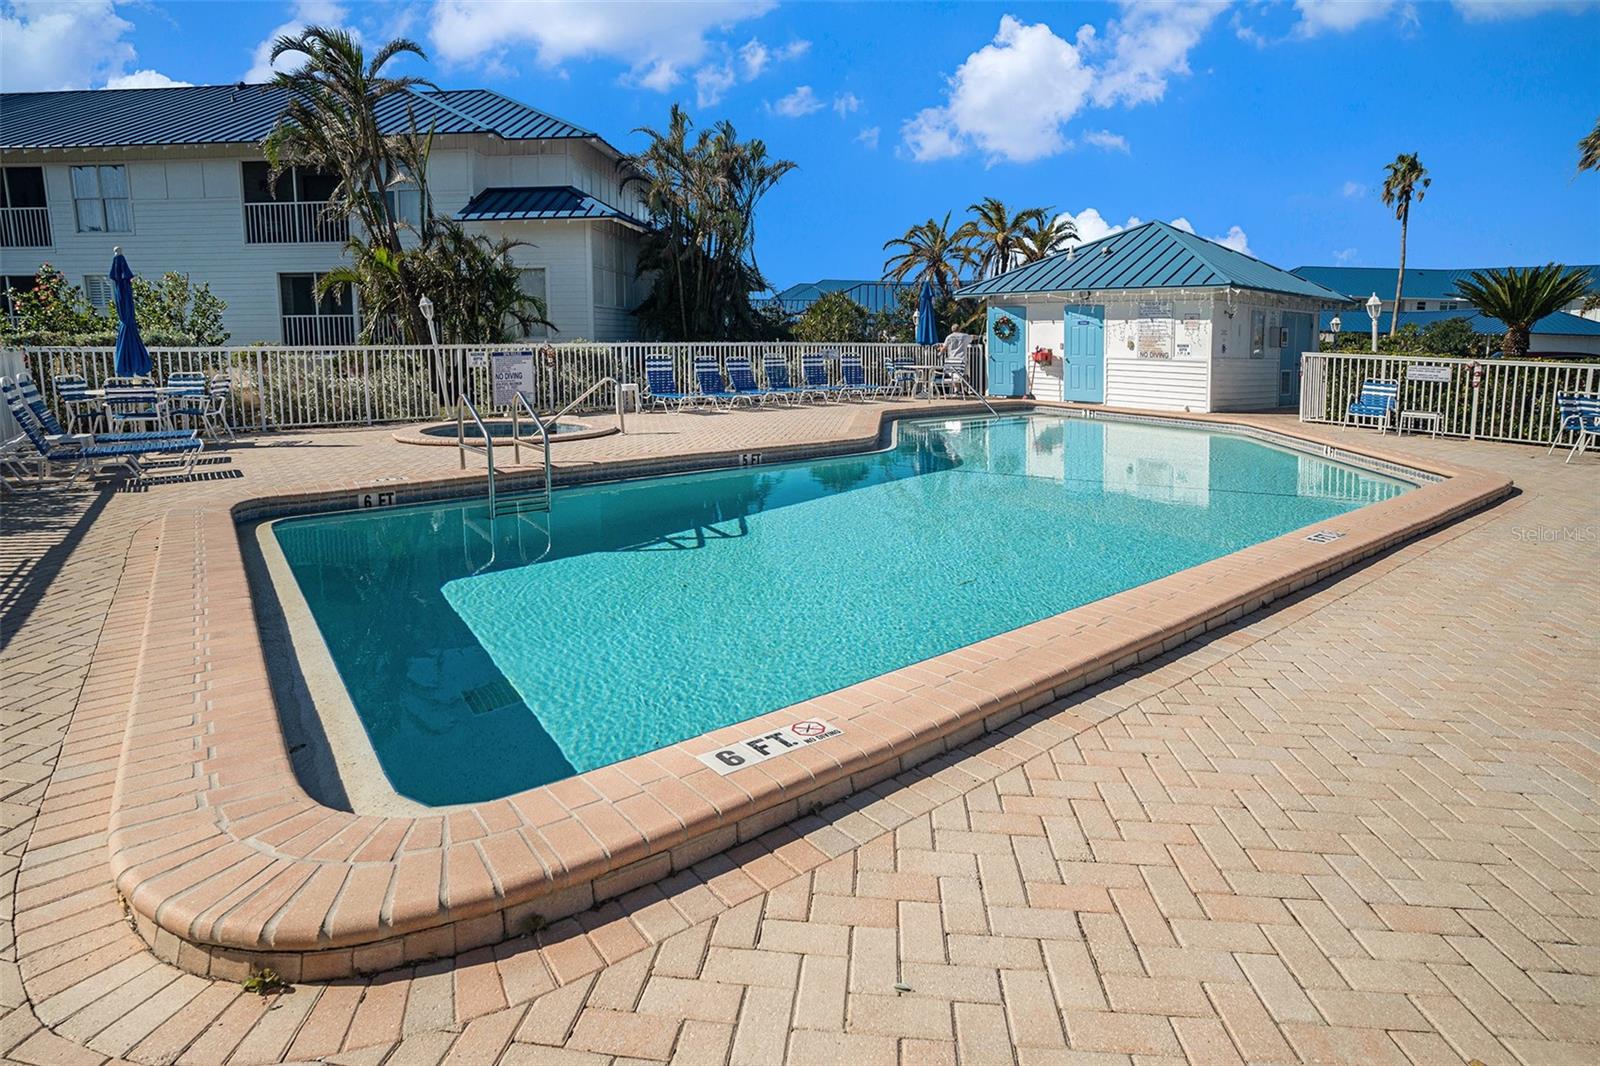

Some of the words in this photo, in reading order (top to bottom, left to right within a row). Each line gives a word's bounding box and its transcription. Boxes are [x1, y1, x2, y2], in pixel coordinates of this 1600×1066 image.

[505, 372, 523, 380] DIVING
[742, 454, 748, 465] 5
[751, 453, 761, 464] FT
[364, 494, 372, 508] 6
[378, 492, 394, 506] FT
[803, 737, 816, 745] NO
[816, 729, 842, 742] DIVING
[715, 750, 746, 766] 6
[746, 732, 799, 756] FT.
